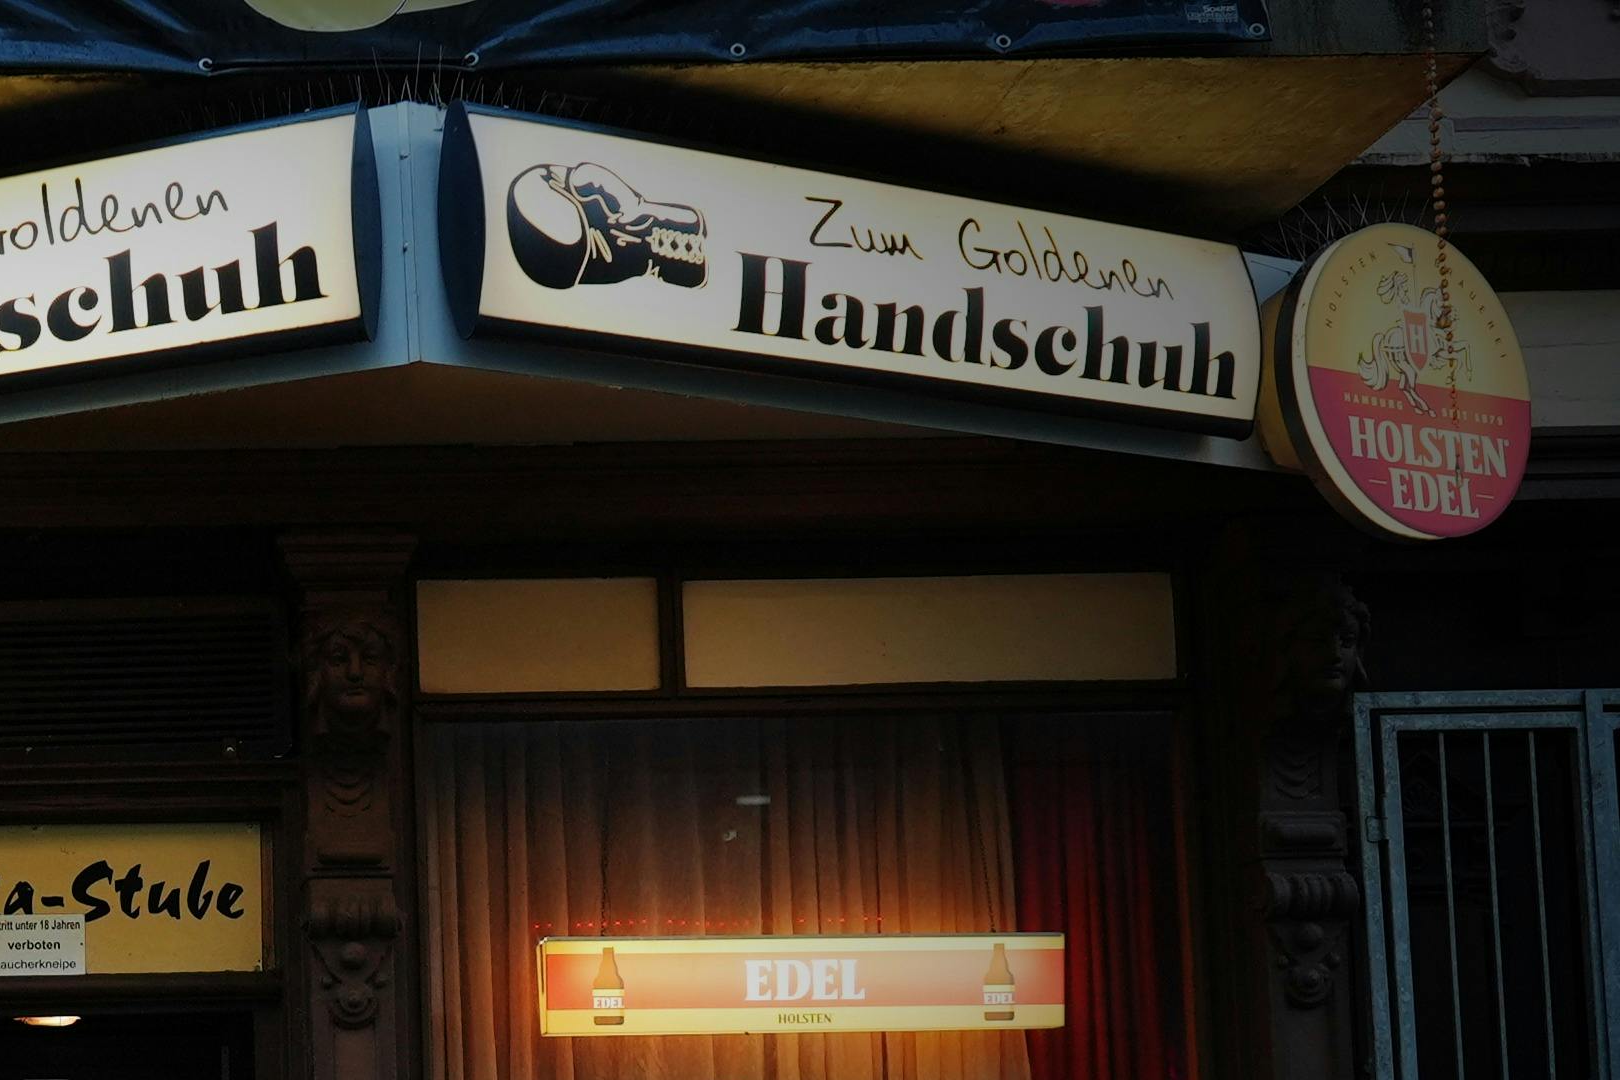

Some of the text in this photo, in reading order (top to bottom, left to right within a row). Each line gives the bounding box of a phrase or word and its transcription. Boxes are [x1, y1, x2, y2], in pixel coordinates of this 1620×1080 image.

[805, 196, 1175, 301] Zum Goldenen
[732, 251, 1237, 400] Handschuh
[1348, 415, 1508, 479] HOLSTEN
[1388, 467, 1480, 519] EDEL
[7, 940, 61, 950] verboten
[15, 920, 38, 931] unter
[40, 920, 50, 930] 18
[51, 919, 81, 930] Jahren
[743, 958, 866, 1002] EDEL
[777, 1012, 832, 1025] HOLSTEN
